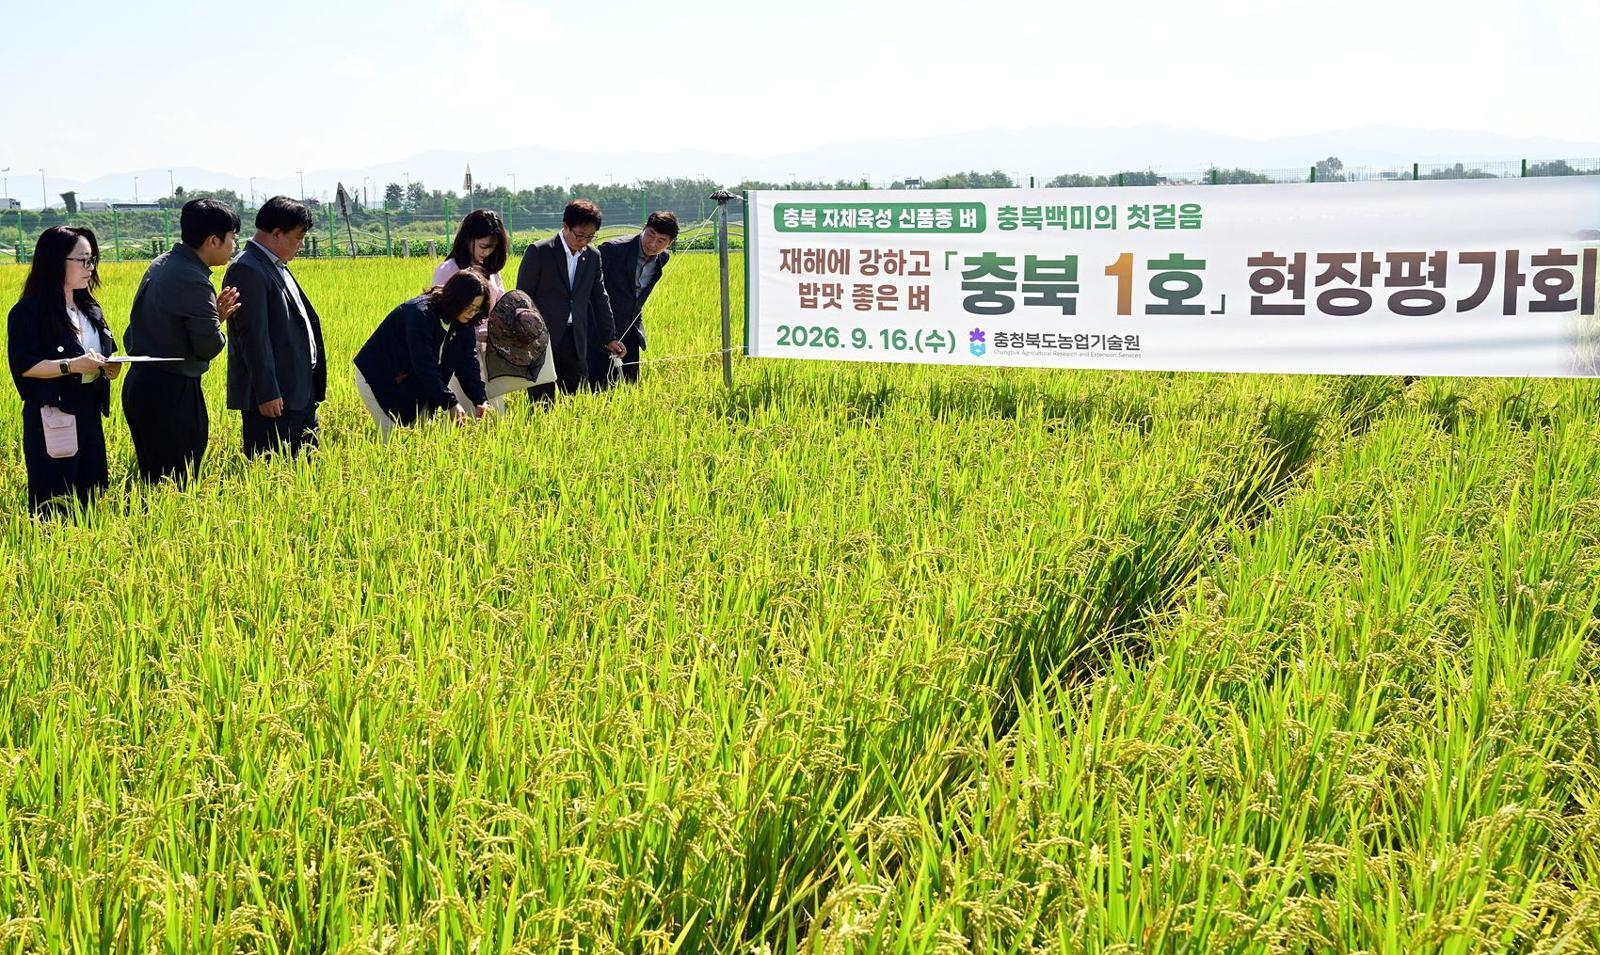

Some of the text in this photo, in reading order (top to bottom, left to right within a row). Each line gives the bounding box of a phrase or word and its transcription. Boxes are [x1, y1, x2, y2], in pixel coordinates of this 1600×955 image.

[783, 207, 977, 229] 충북 자체육성 신품종 벼
[996, 203, 1203, 232] 충북백미의 첫걸음
[779, 247, 932, 277] 재해에 강하고
[798, 282, 930, 313] 밥맛 좋은 벼
[1246, 248, 1597, 317] 현장평가회
[776, 324, 956, 355] 2026. 9. 16.(수)
[993, 331, 1141, 351] 충청북도농업기술원
